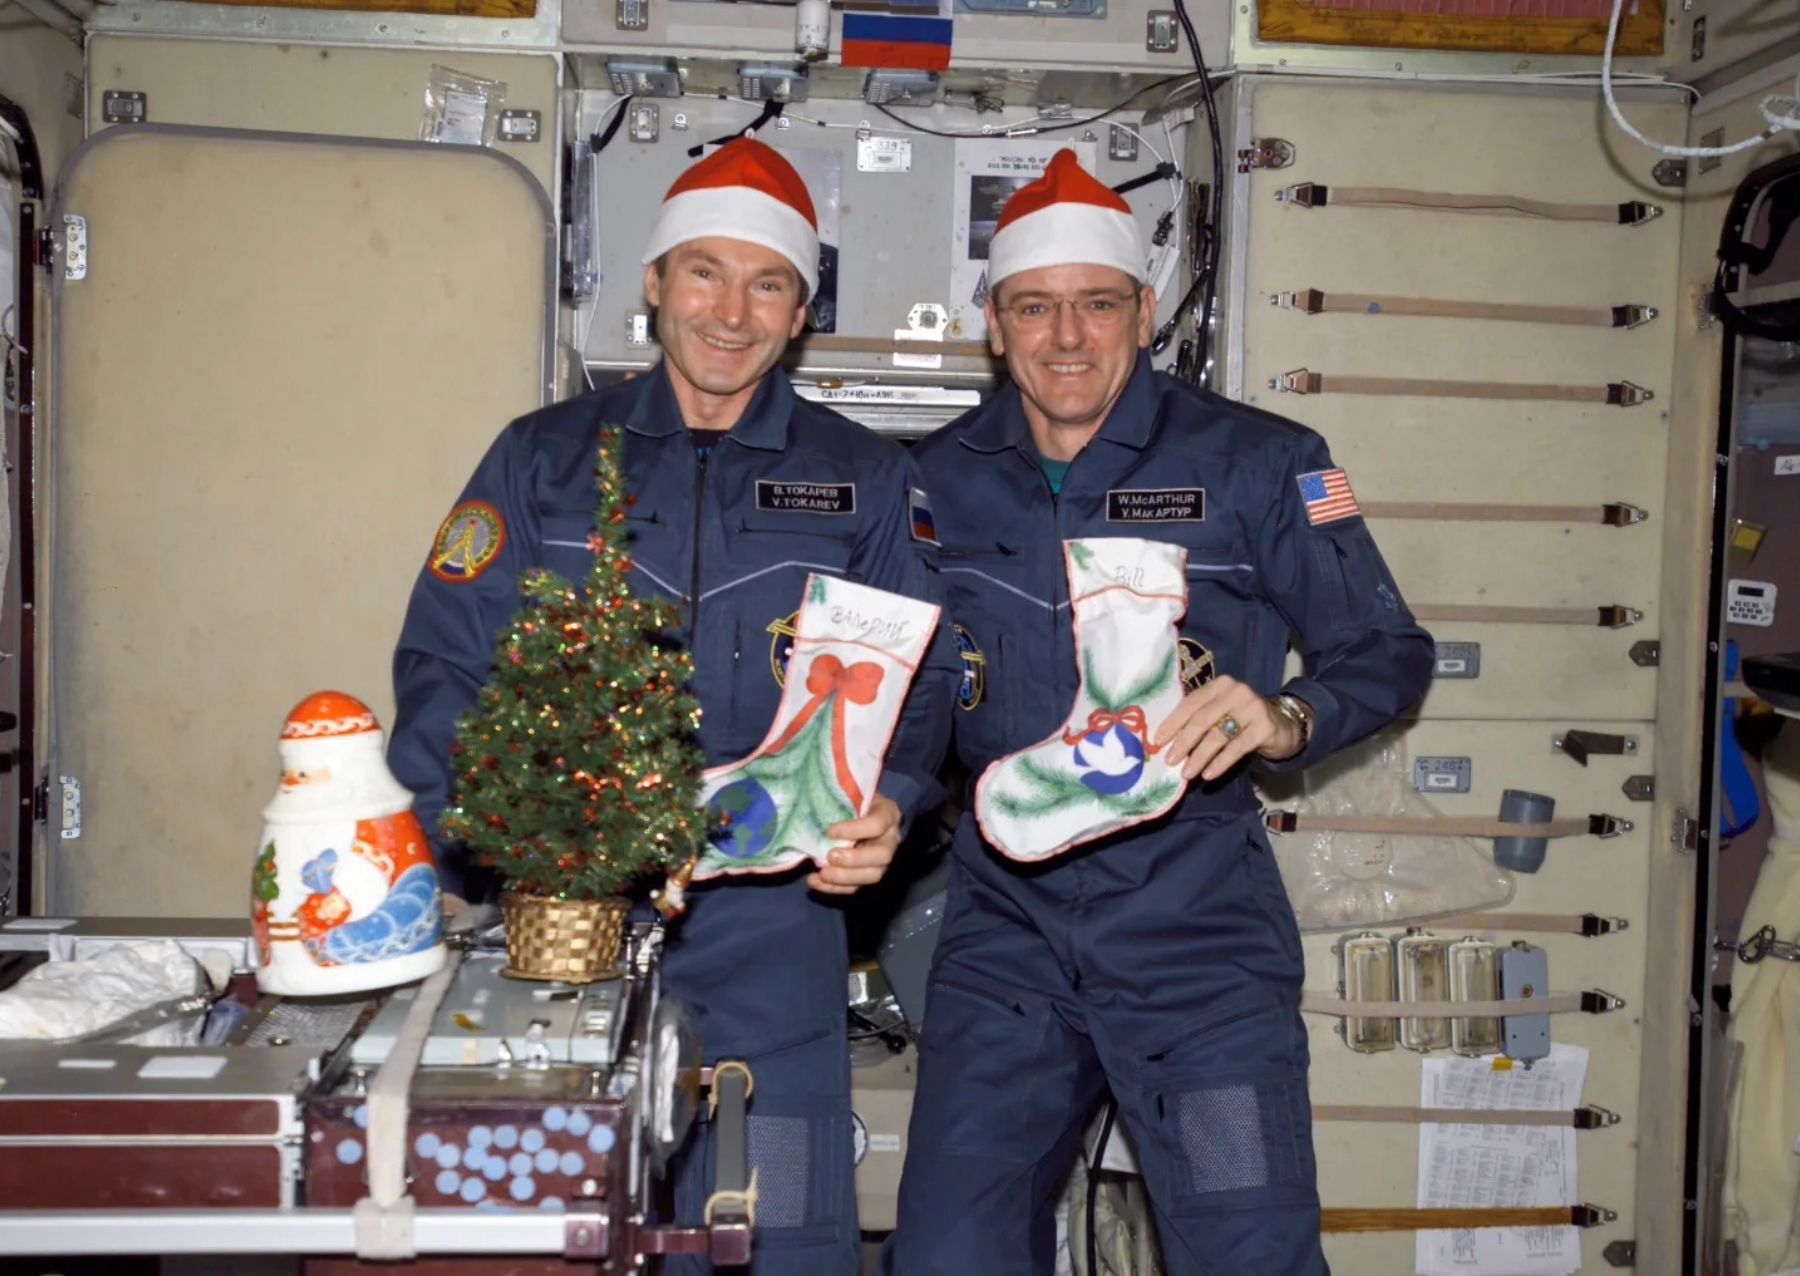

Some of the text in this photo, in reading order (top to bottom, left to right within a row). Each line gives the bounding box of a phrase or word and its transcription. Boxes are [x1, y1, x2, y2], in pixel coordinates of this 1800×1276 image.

[772, 496, 840, 510] V.TOKAREV
[1117, 493, 1196, 506] W.McARTHUR
[1115, 565, 1145, 588] Bill
